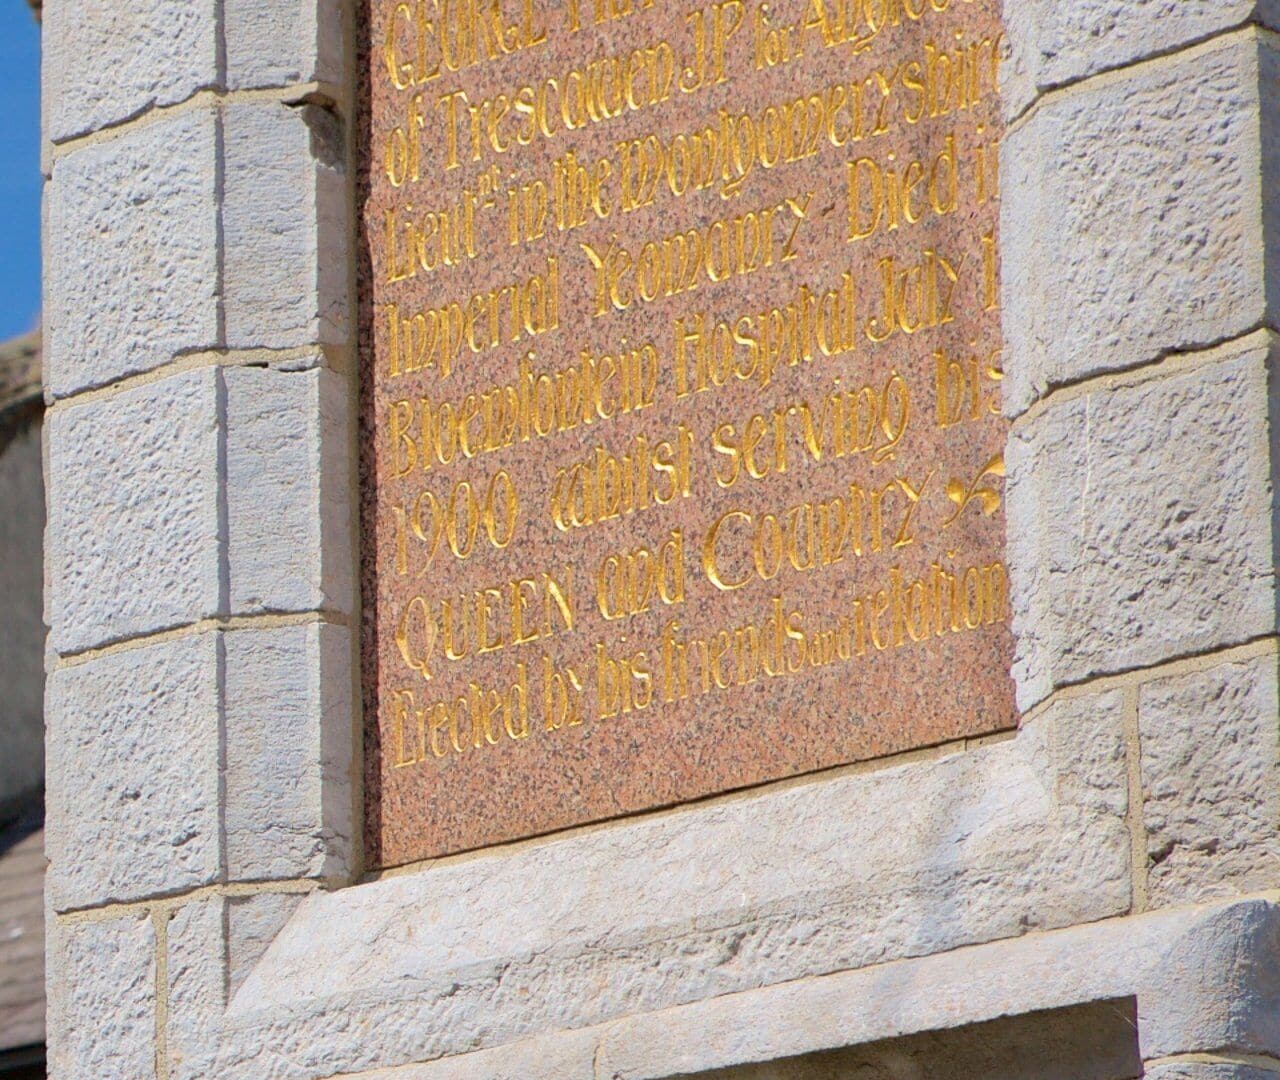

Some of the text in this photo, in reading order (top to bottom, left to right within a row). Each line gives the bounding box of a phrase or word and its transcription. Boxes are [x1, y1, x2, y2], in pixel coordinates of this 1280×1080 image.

[385, 95, 424, 187] of
[678, 2, 744, 93] JP
[754, 3, 794, 70] for
[508, 171, 547, 246] in
[553, 150, 612, 231] the
[384, 254, 559, 379] Imperial
[580, 191, 814, 317] Yeomanry
[846, 132, 958, 243] Died
[388, 337, 657, 480] Bloemfontein
[673, 270, 856, 398] Hospital
[865, 246, 969, 343] July
[392, 468, 520, 578] 1900
[551, 425, 694, 532] whilst
[712, 370, 910, 489] serving
[395, 469, 936, 680] QUEEN and Country
[393, 661, 529, 768] Erected
[543, 654, 589, 731] by
[596, 636, 653, 720] his
[662, 596, 807, 702] friends
[810, 614, 851, 667] and
